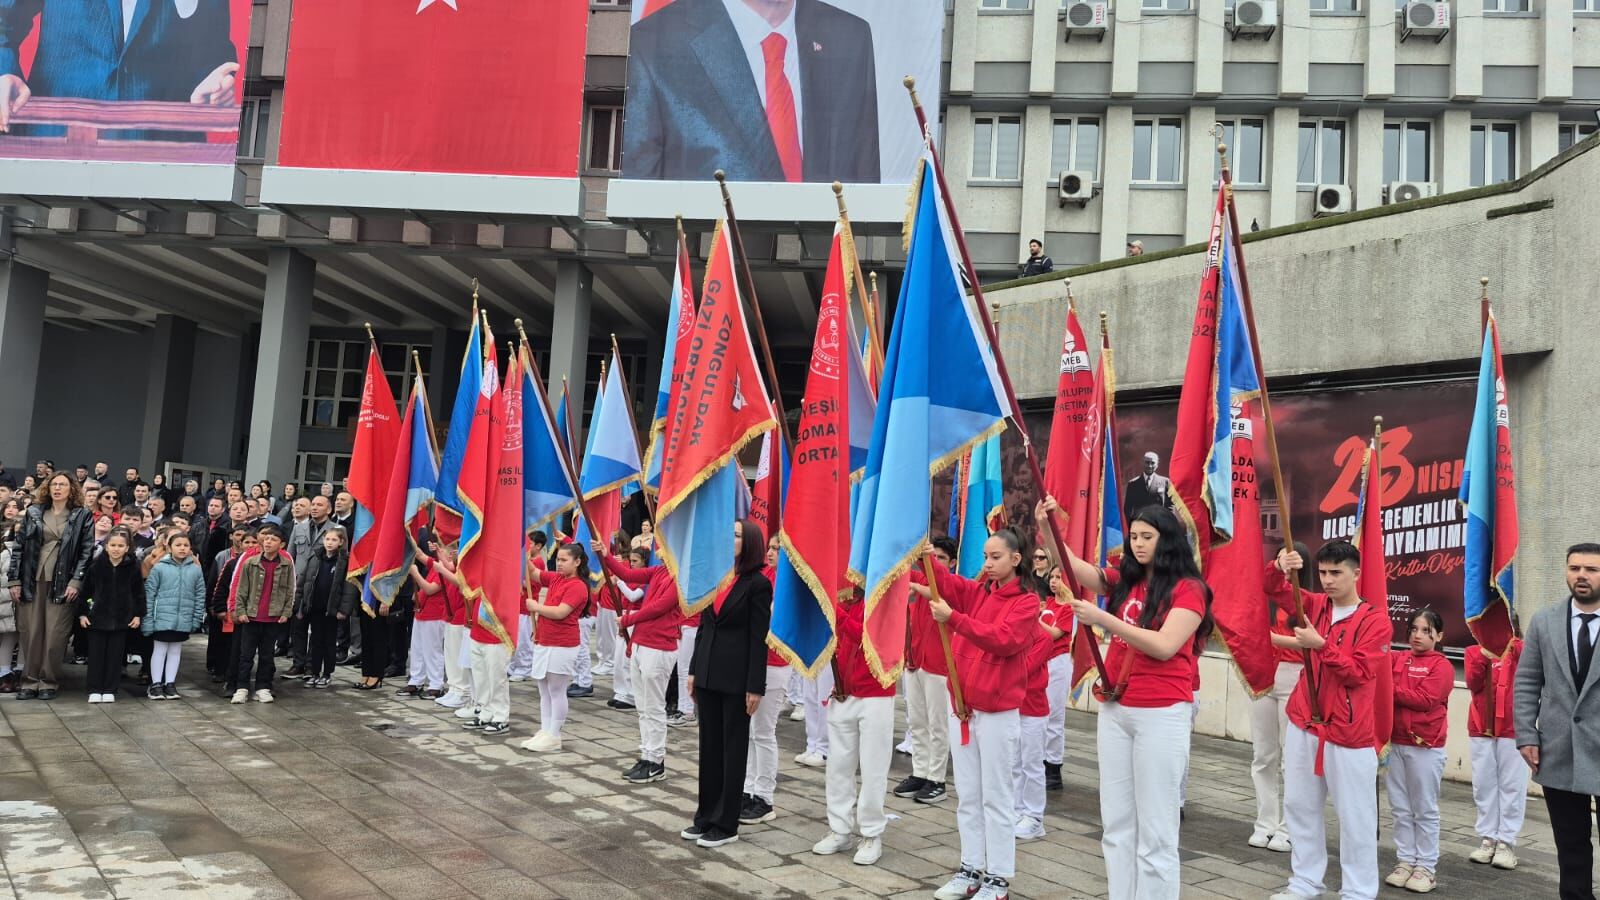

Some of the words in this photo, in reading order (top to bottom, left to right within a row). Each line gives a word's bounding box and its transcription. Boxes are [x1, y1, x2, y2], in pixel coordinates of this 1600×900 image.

[697, 279, 722, 331] GAZİ
[1062, 356, 1081, 366] MEB
[689, 312, 733, 446] ZONGULDAK
[802, 396, 839, 419] YEŞİ
[1231, 471, 1254, 483] OLU
[1319, 426, 1415, 513] 23
[500, 477, 518, 486] 1953
[1233, 488, 1248, 499] EK
